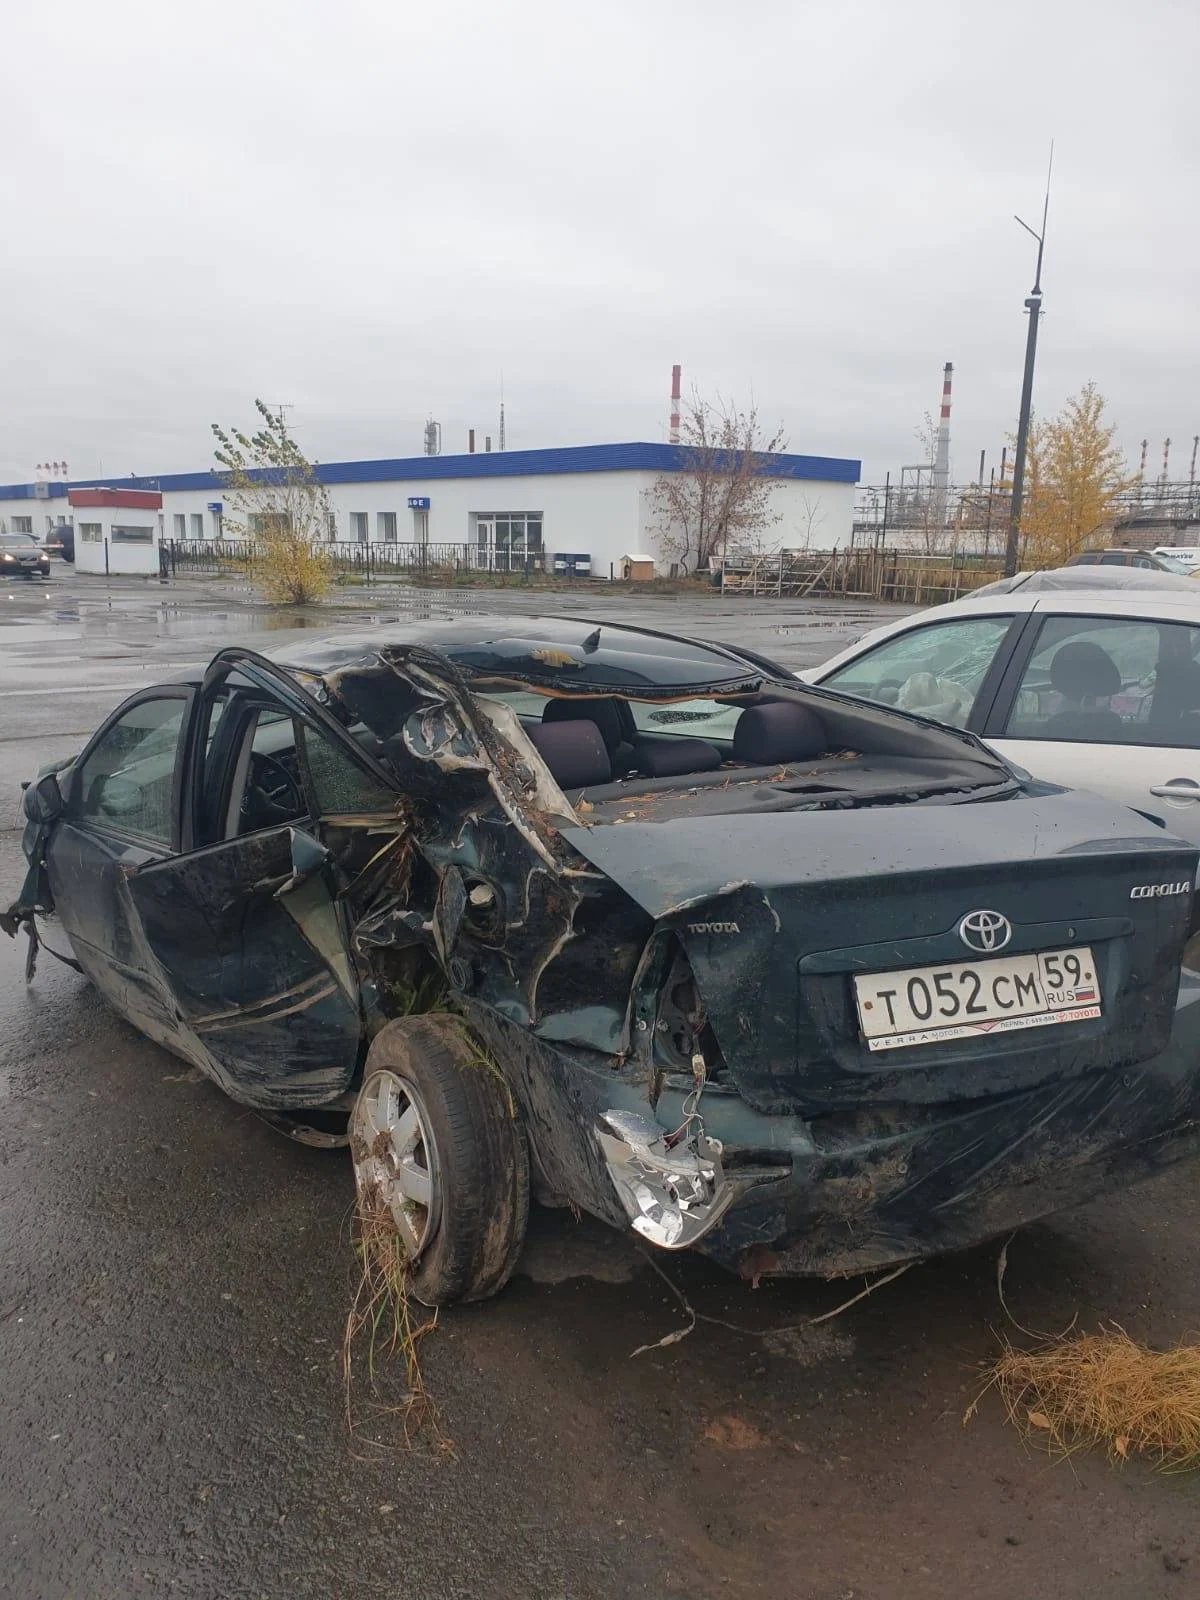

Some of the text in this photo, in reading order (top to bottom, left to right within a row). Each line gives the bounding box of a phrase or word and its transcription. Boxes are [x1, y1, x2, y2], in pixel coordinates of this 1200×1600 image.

[1130, 881, 1190, 899] COROLLA
[687, 922, 740, 933] TOYOTA
[1044, 954, 1081, 989] 59
[1046, 990, 1075, 1005] RUS
[1070, 1008, 1100, 1019] TOYOTA
